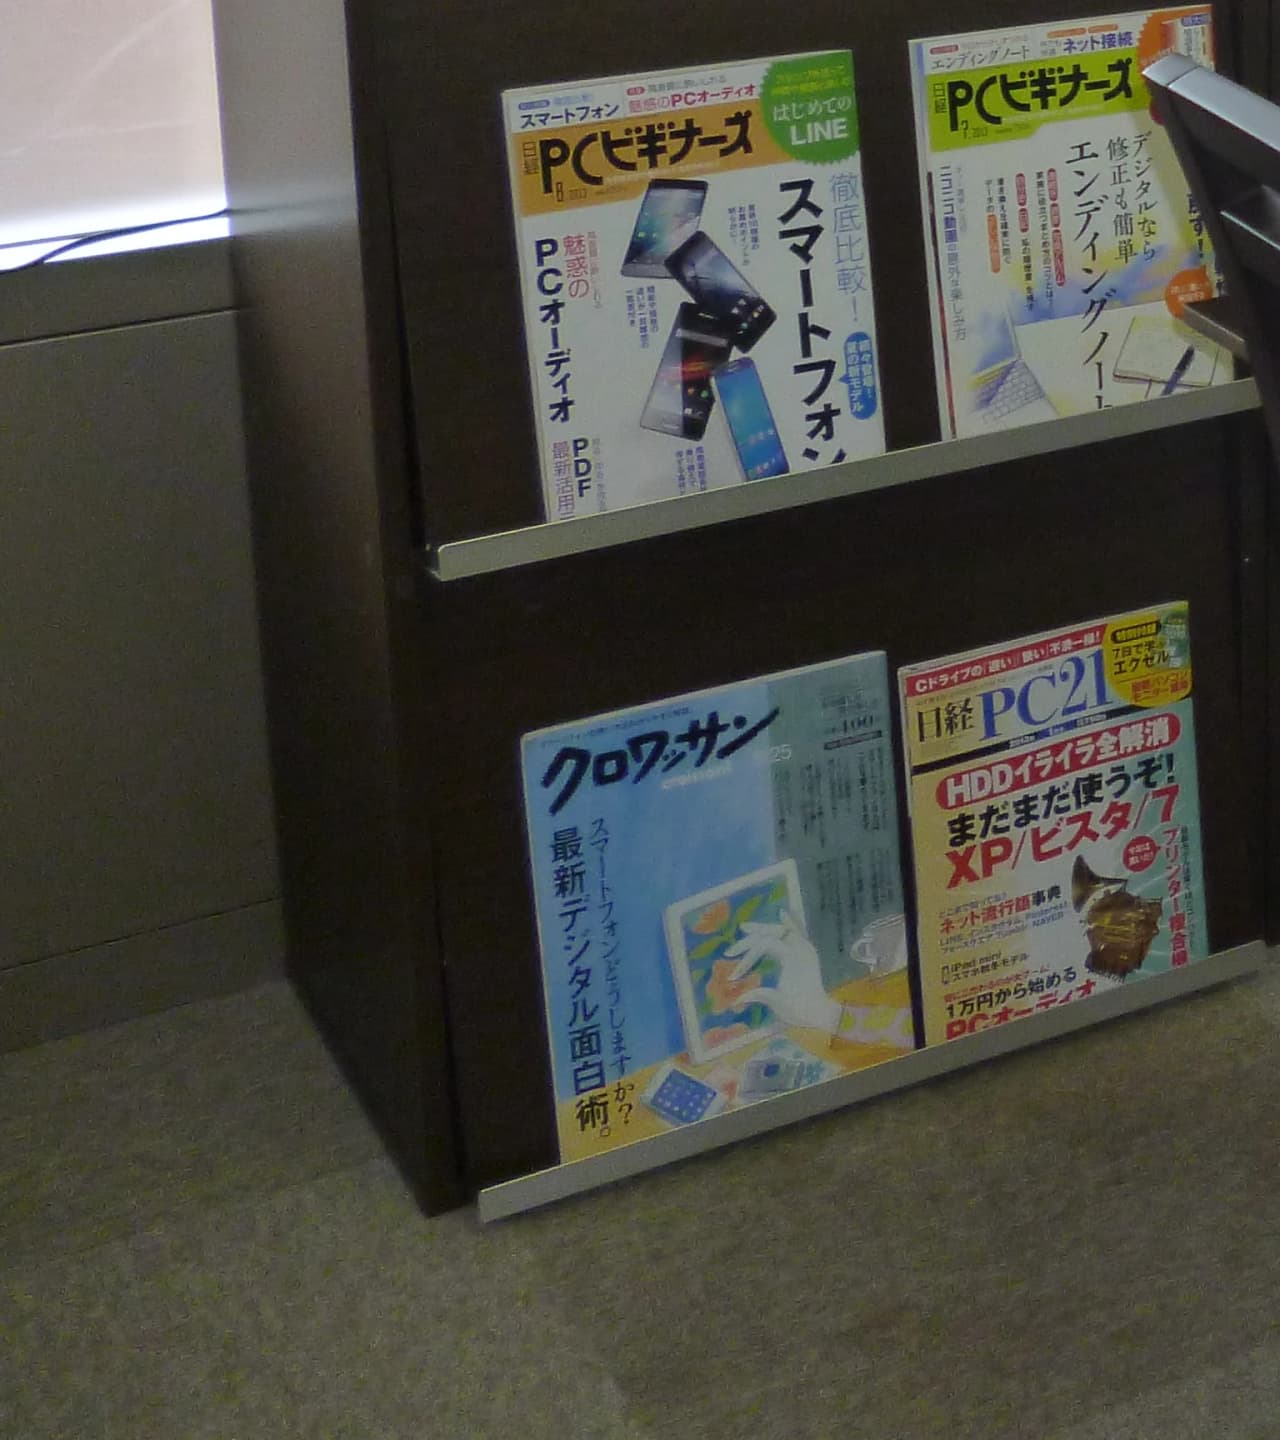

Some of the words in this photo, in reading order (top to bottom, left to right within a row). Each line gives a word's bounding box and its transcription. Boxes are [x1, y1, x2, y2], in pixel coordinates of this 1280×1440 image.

[1063, 30, 1135, 56] ネット接続
[519, 102, 621, 129] スマートフォン
[628, 82, 757, 114] 魅惑のPCオーディオ
[772, 95, 853, 122] はじめての
[789, 118, 849, 147] LINE
[946, 56, 1134, 133] PCビギナーズ
[538, 109, 754, 195] PCビギナーズ
[1131, 129, 1158, 264] デジタルなら
[1106, 134, 1139, 265] 修正も簡単
[563, 234, 591, 299] 魅惑の
[829, 172, 868, 325] 徹底比較!
[534, 237, 576, 423] PCオーディオ
[552, 440, 576, 519] 最新活用
[571, 437, 593, 499] PDF
[916, 696, 976, 743] 日経
[977, 648, 1114, 742] PC21
[540, 705, 781, 817] クロワッサン
[945, 716, 1171, 809] HDDイライラ全解消
[947, 751, 1176, 849] まだまだ使うぞ!
[944, 783, 1182, 890] XP/ビスタ/7
[549, 825, 612, 1139] 最新デジタル面白術。
[589, 816, 636, 1126] スマートフォンどうしますか?
[945, 965, 1079, 1019] 1万円から始める
